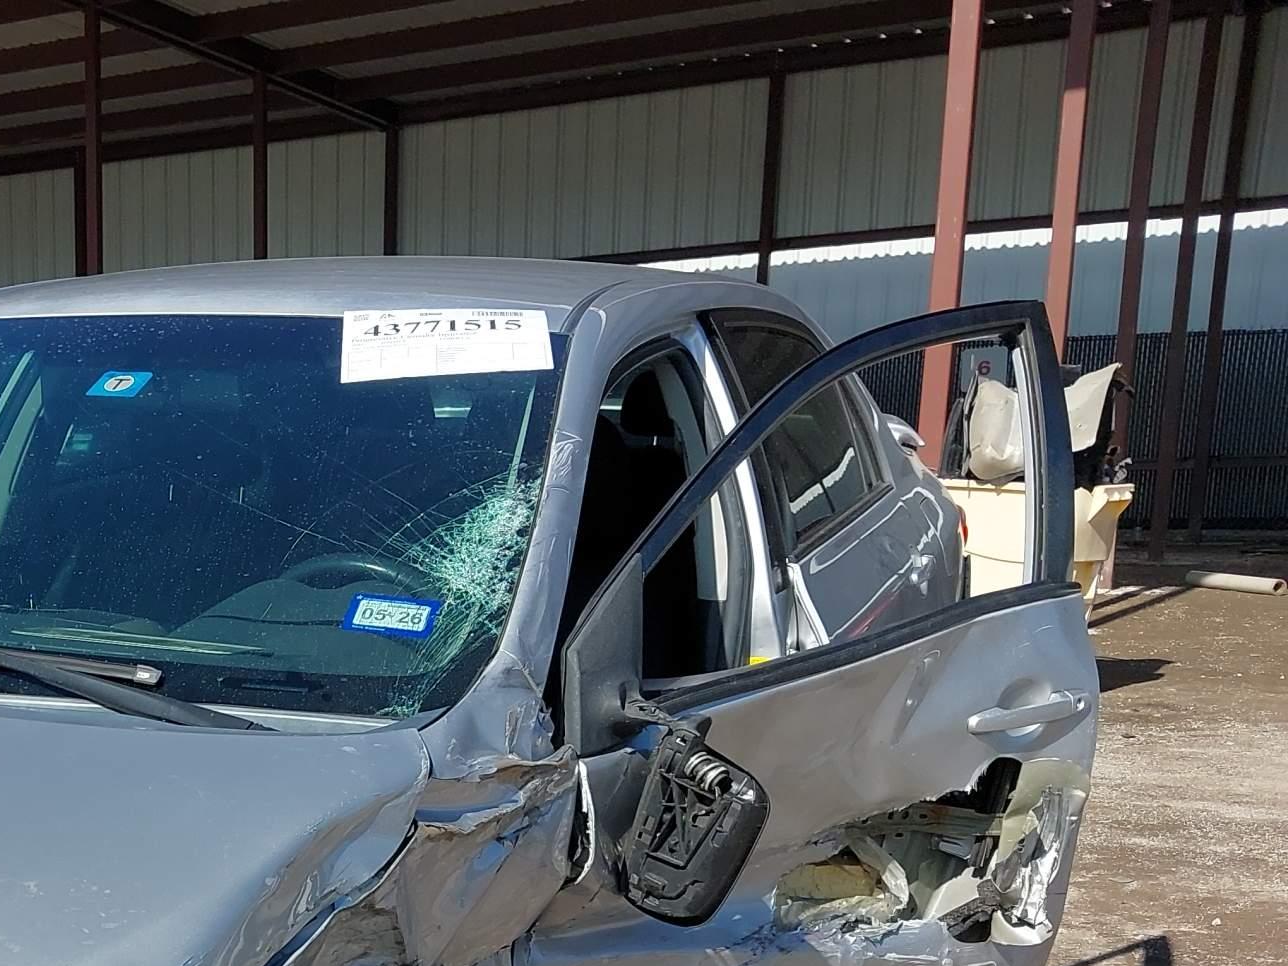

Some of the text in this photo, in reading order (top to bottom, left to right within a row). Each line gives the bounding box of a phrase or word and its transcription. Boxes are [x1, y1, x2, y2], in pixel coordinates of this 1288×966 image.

[363, 319, 522, 337] 43771515
[977, 360, 991, 376] 6
[111, 377, 131, 390] T
[361, 607, 423, 625] 05 26
